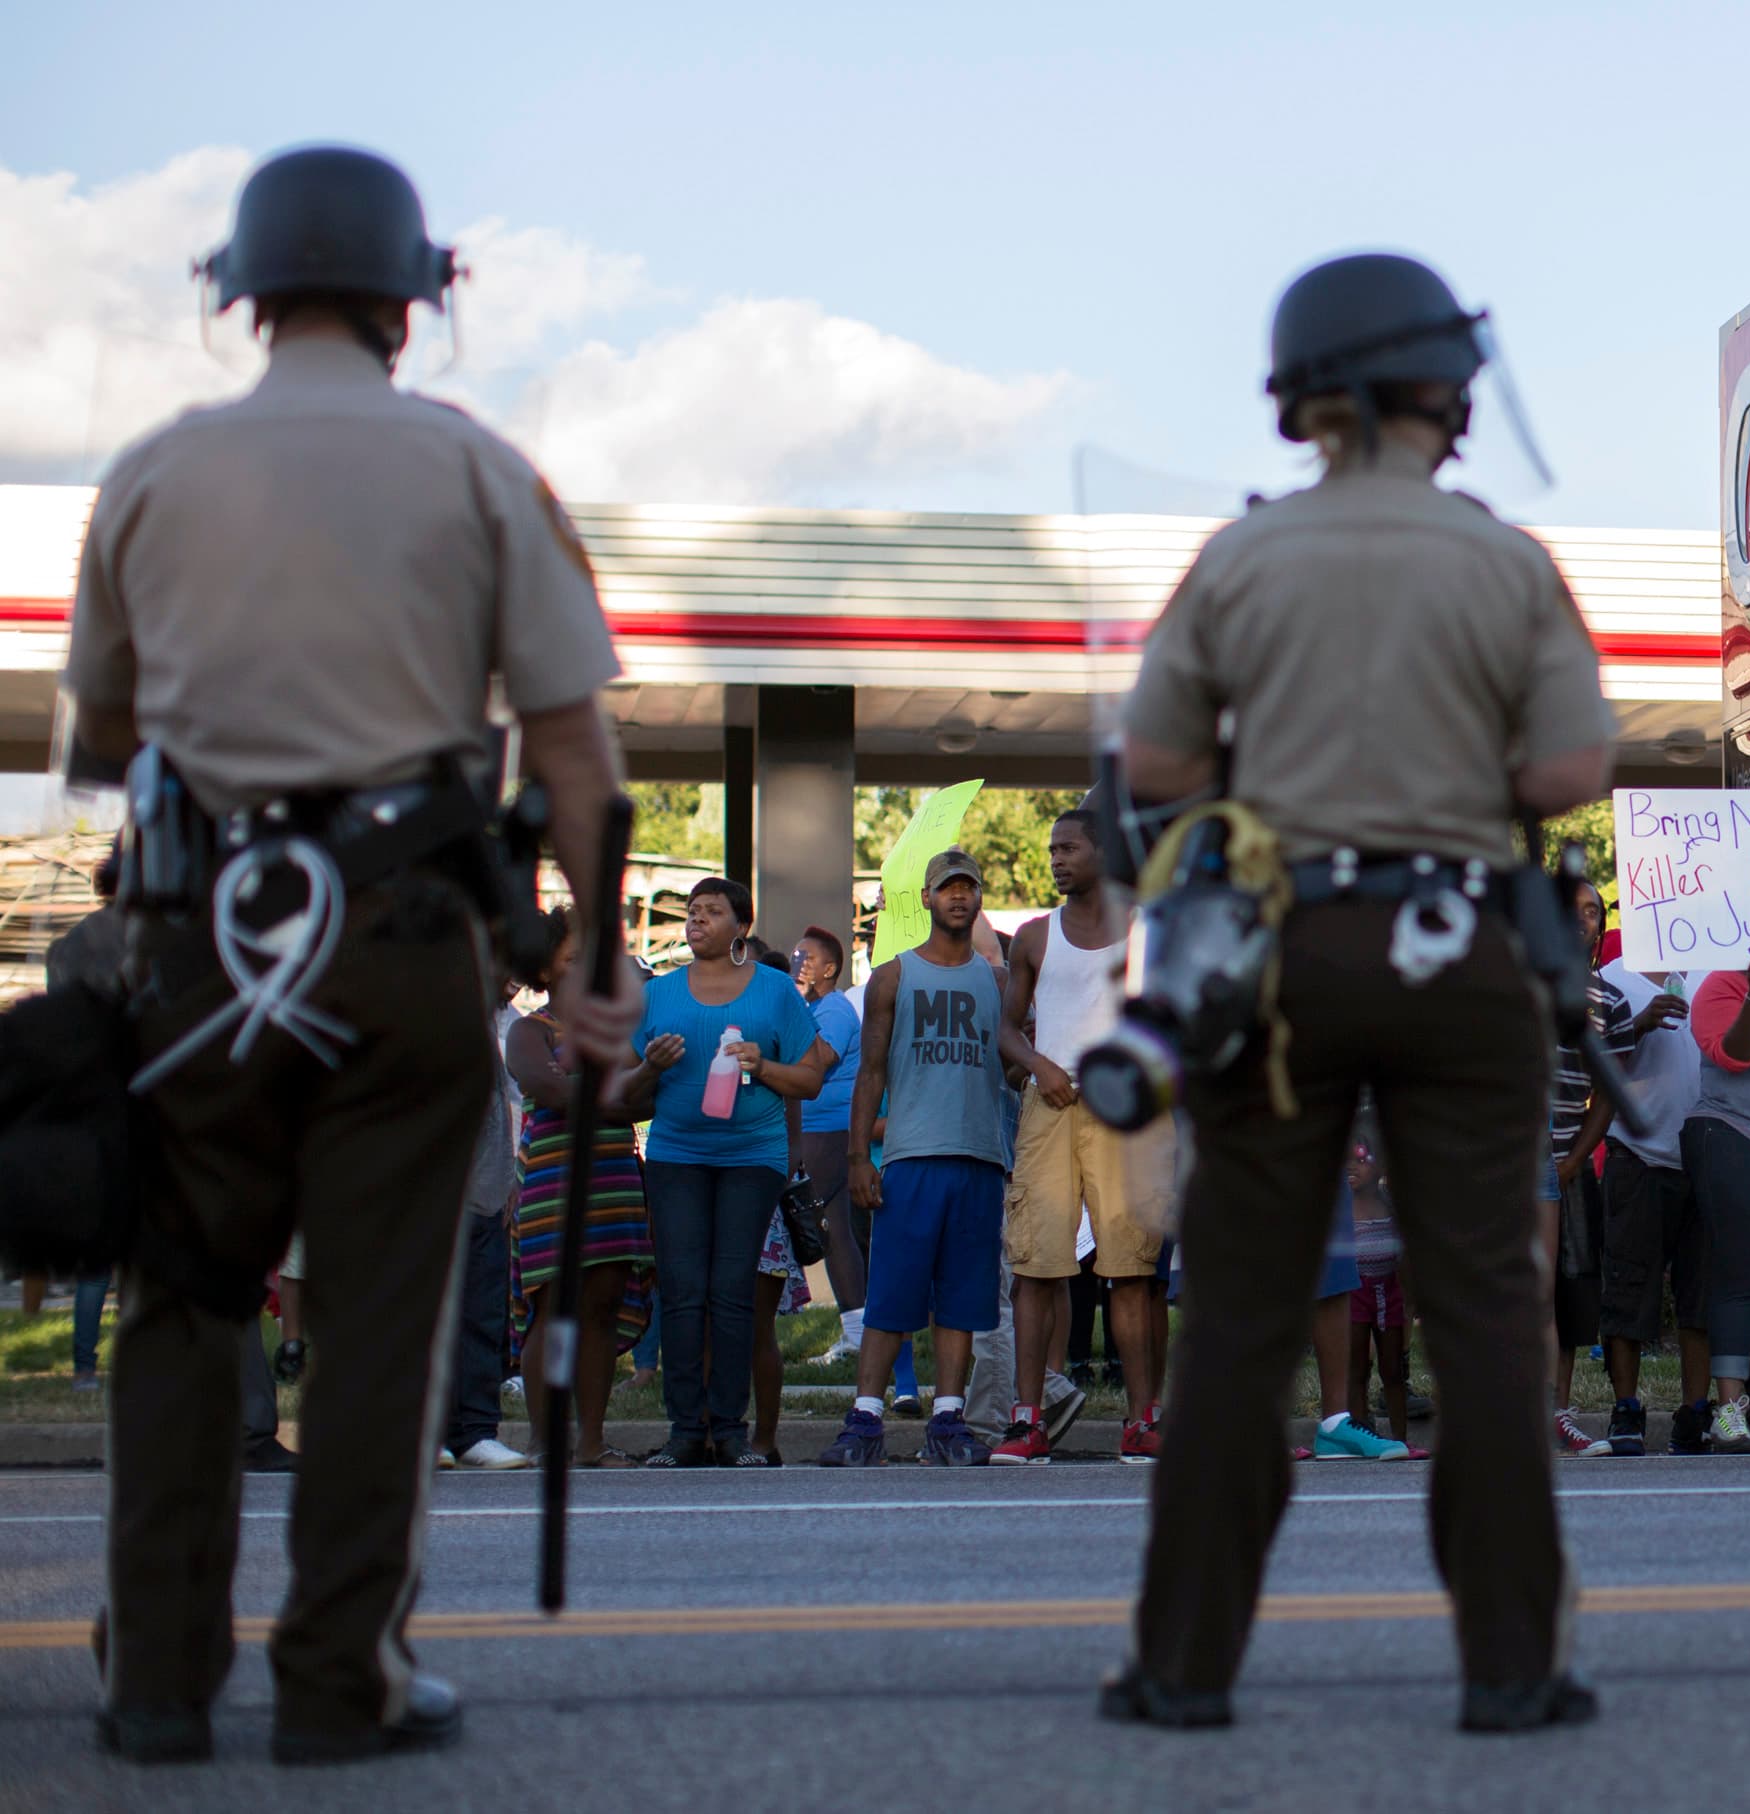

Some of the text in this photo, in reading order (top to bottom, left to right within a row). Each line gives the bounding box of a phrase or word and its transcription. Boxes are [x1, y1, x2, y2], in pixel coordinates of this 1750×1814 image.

[1629, 792, 1721, 846] Bring
[1627, 854, 1713, 906] Killer
[890, 888, 930, 940] PEA
[913, 989, 991, 1046] MR.
[911, 1040, 986, 1069] TROUBL
